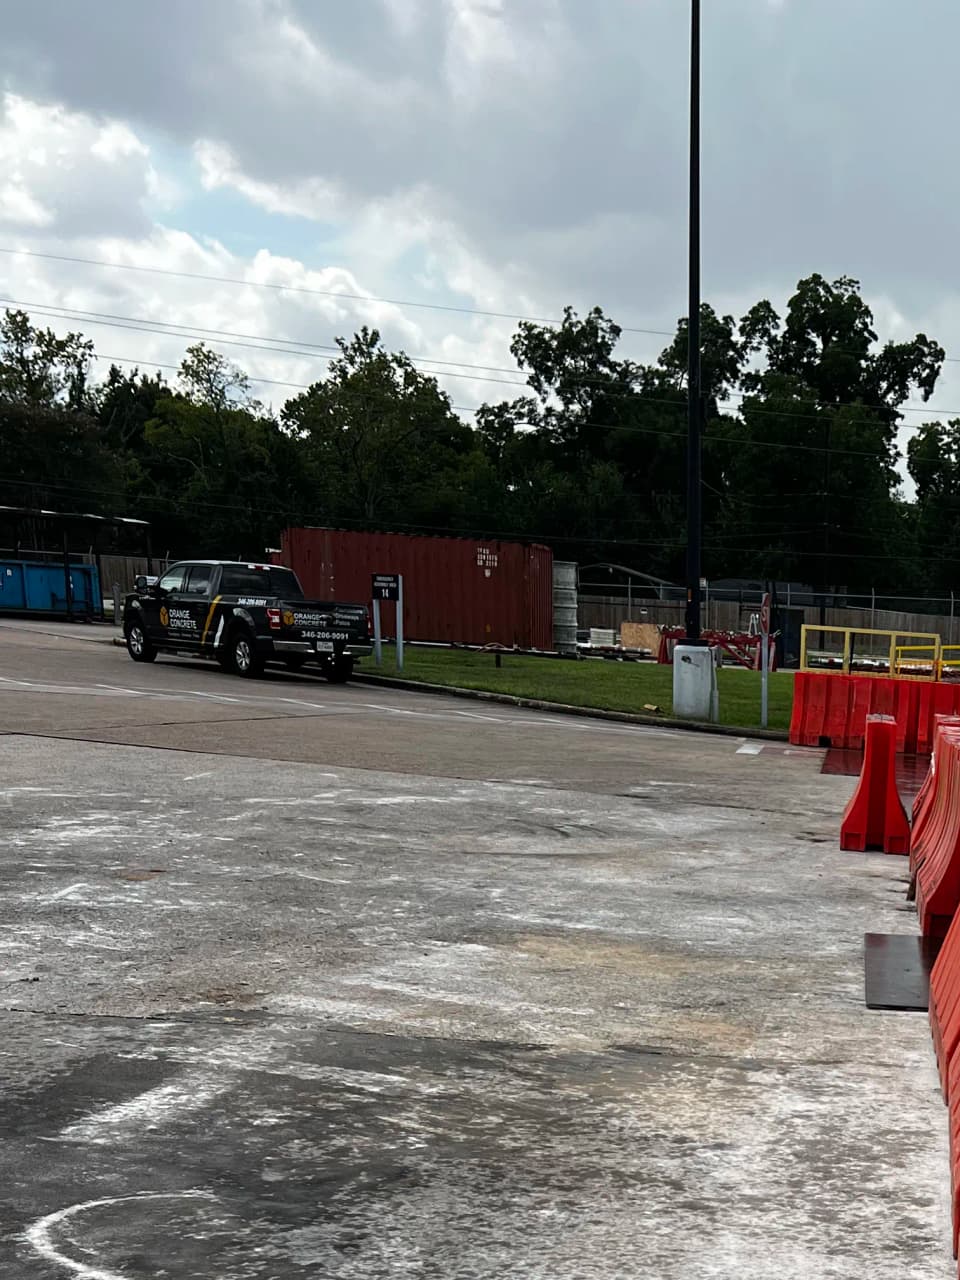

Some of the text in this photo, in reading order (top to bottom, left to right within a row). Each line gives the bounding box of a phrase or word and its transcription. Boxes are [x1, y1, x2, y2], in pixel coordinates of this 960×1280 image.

[169, 608, 191, 619] ORANGE
[293, 612, 320, 620] ORANGE
[170, 618, 197, 629] CONCRETE
[294, 619, 327, 628] CONCRETE
[300, 630, 349, 640] 346-206-9091
